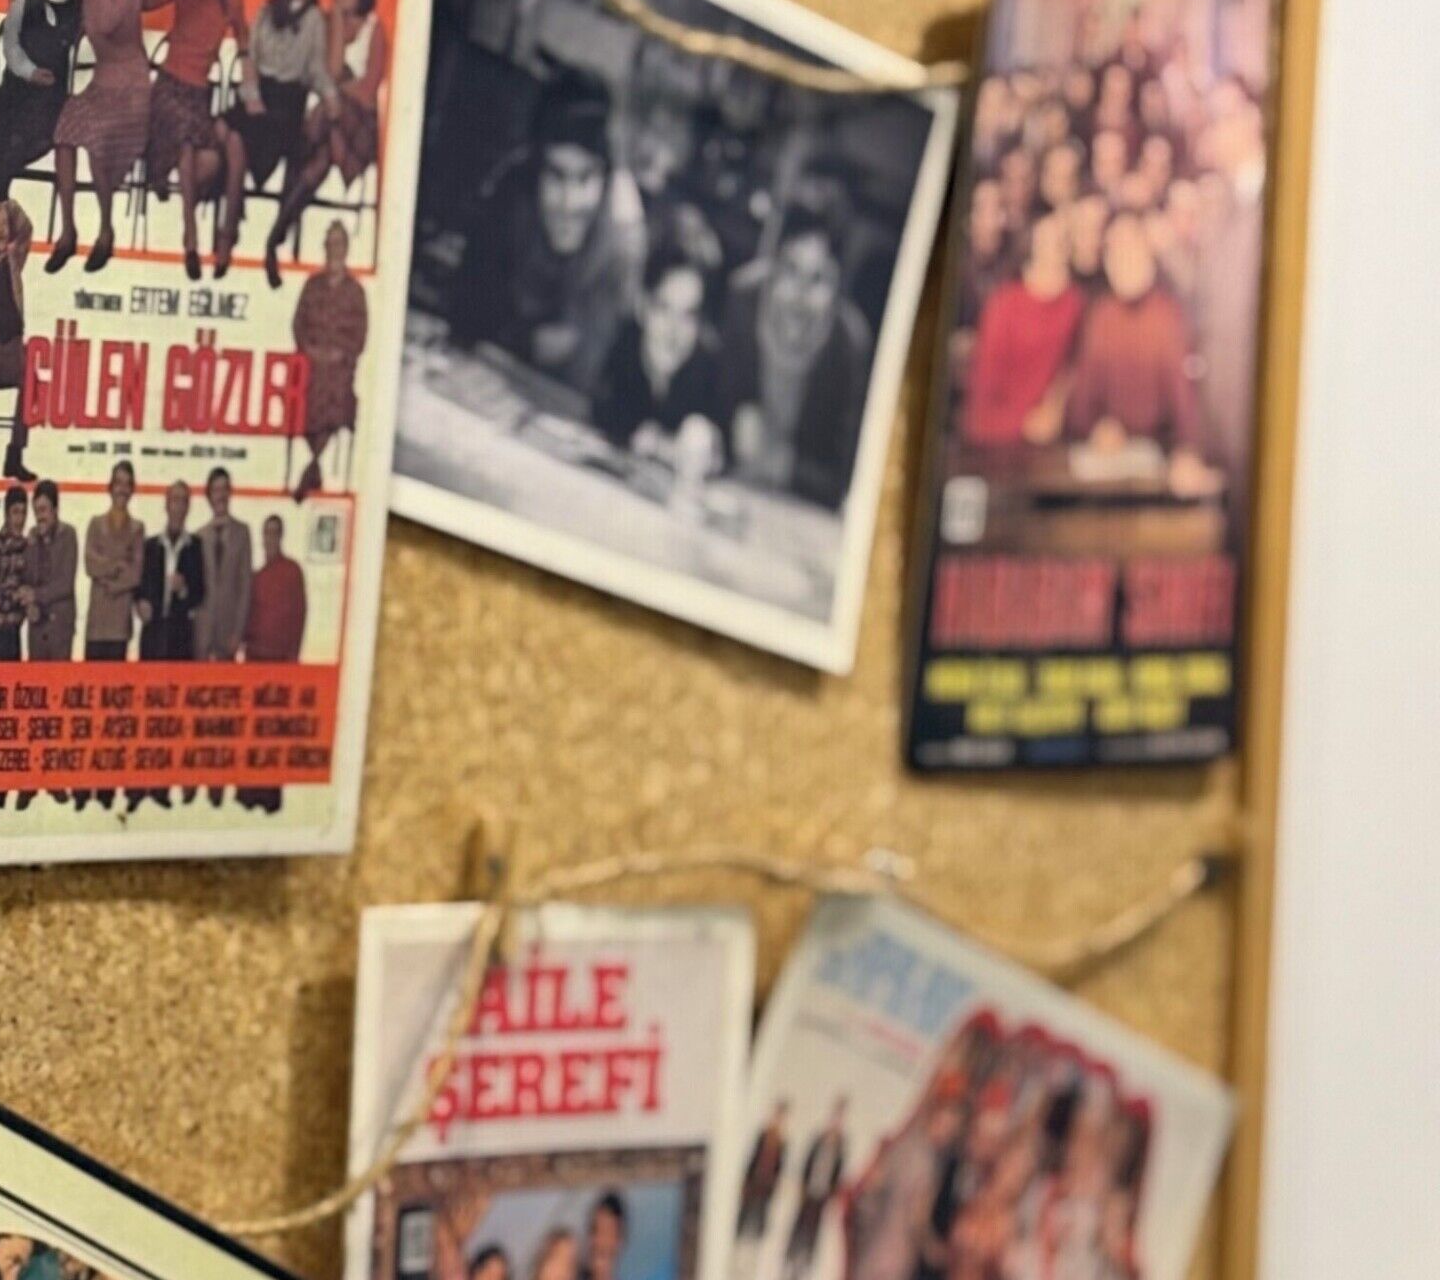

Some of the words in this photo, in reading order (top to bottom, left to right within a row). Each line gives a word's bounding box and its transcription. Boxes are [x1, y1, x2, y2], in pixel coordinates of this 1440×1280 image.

[23, 318, 150, 431] GÜLEN
[162, 327, 308, 437] GÖZLER
[467, 938, 628, 1035] AİLE
